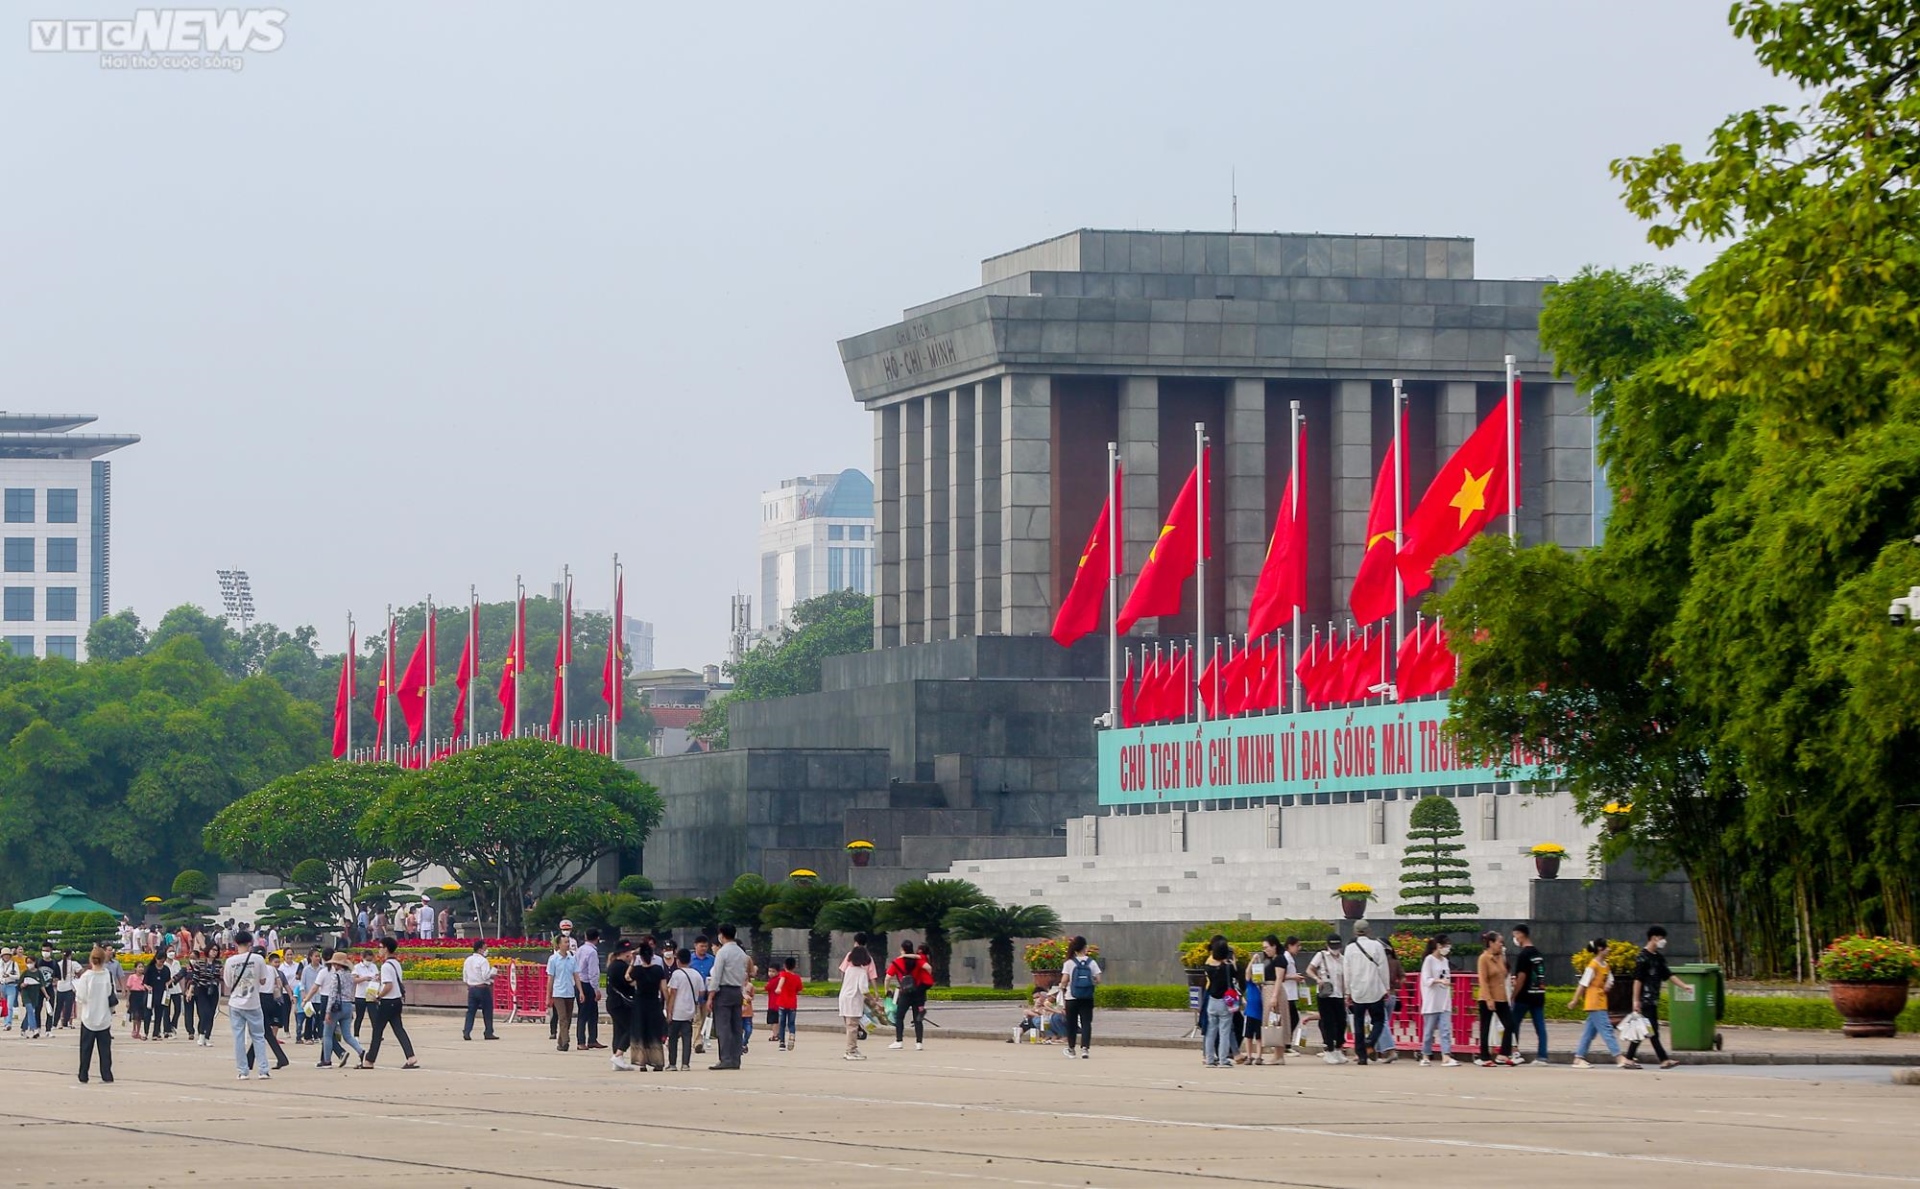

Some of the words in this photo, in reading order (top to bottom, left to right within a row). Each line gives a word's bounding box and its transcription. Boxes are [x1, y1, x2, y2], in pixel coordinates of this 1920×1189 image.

[1120, 730, 1146, 792] CHỦ
[1150, 741, 1180, 799] TỊCH
[1186, 725, 1203, 789] HỒ
[1209, 726, 1232, 786] CHÍ
[1237, 733, 1275, 785] MINH
[1281, 722, 1295, 782] VĨ
[1302, 729, 1327, 789] ĐẠI
[1333, 711, 1376, 779] SỐNG
[1382, 711, 1412, 775] MÃI
